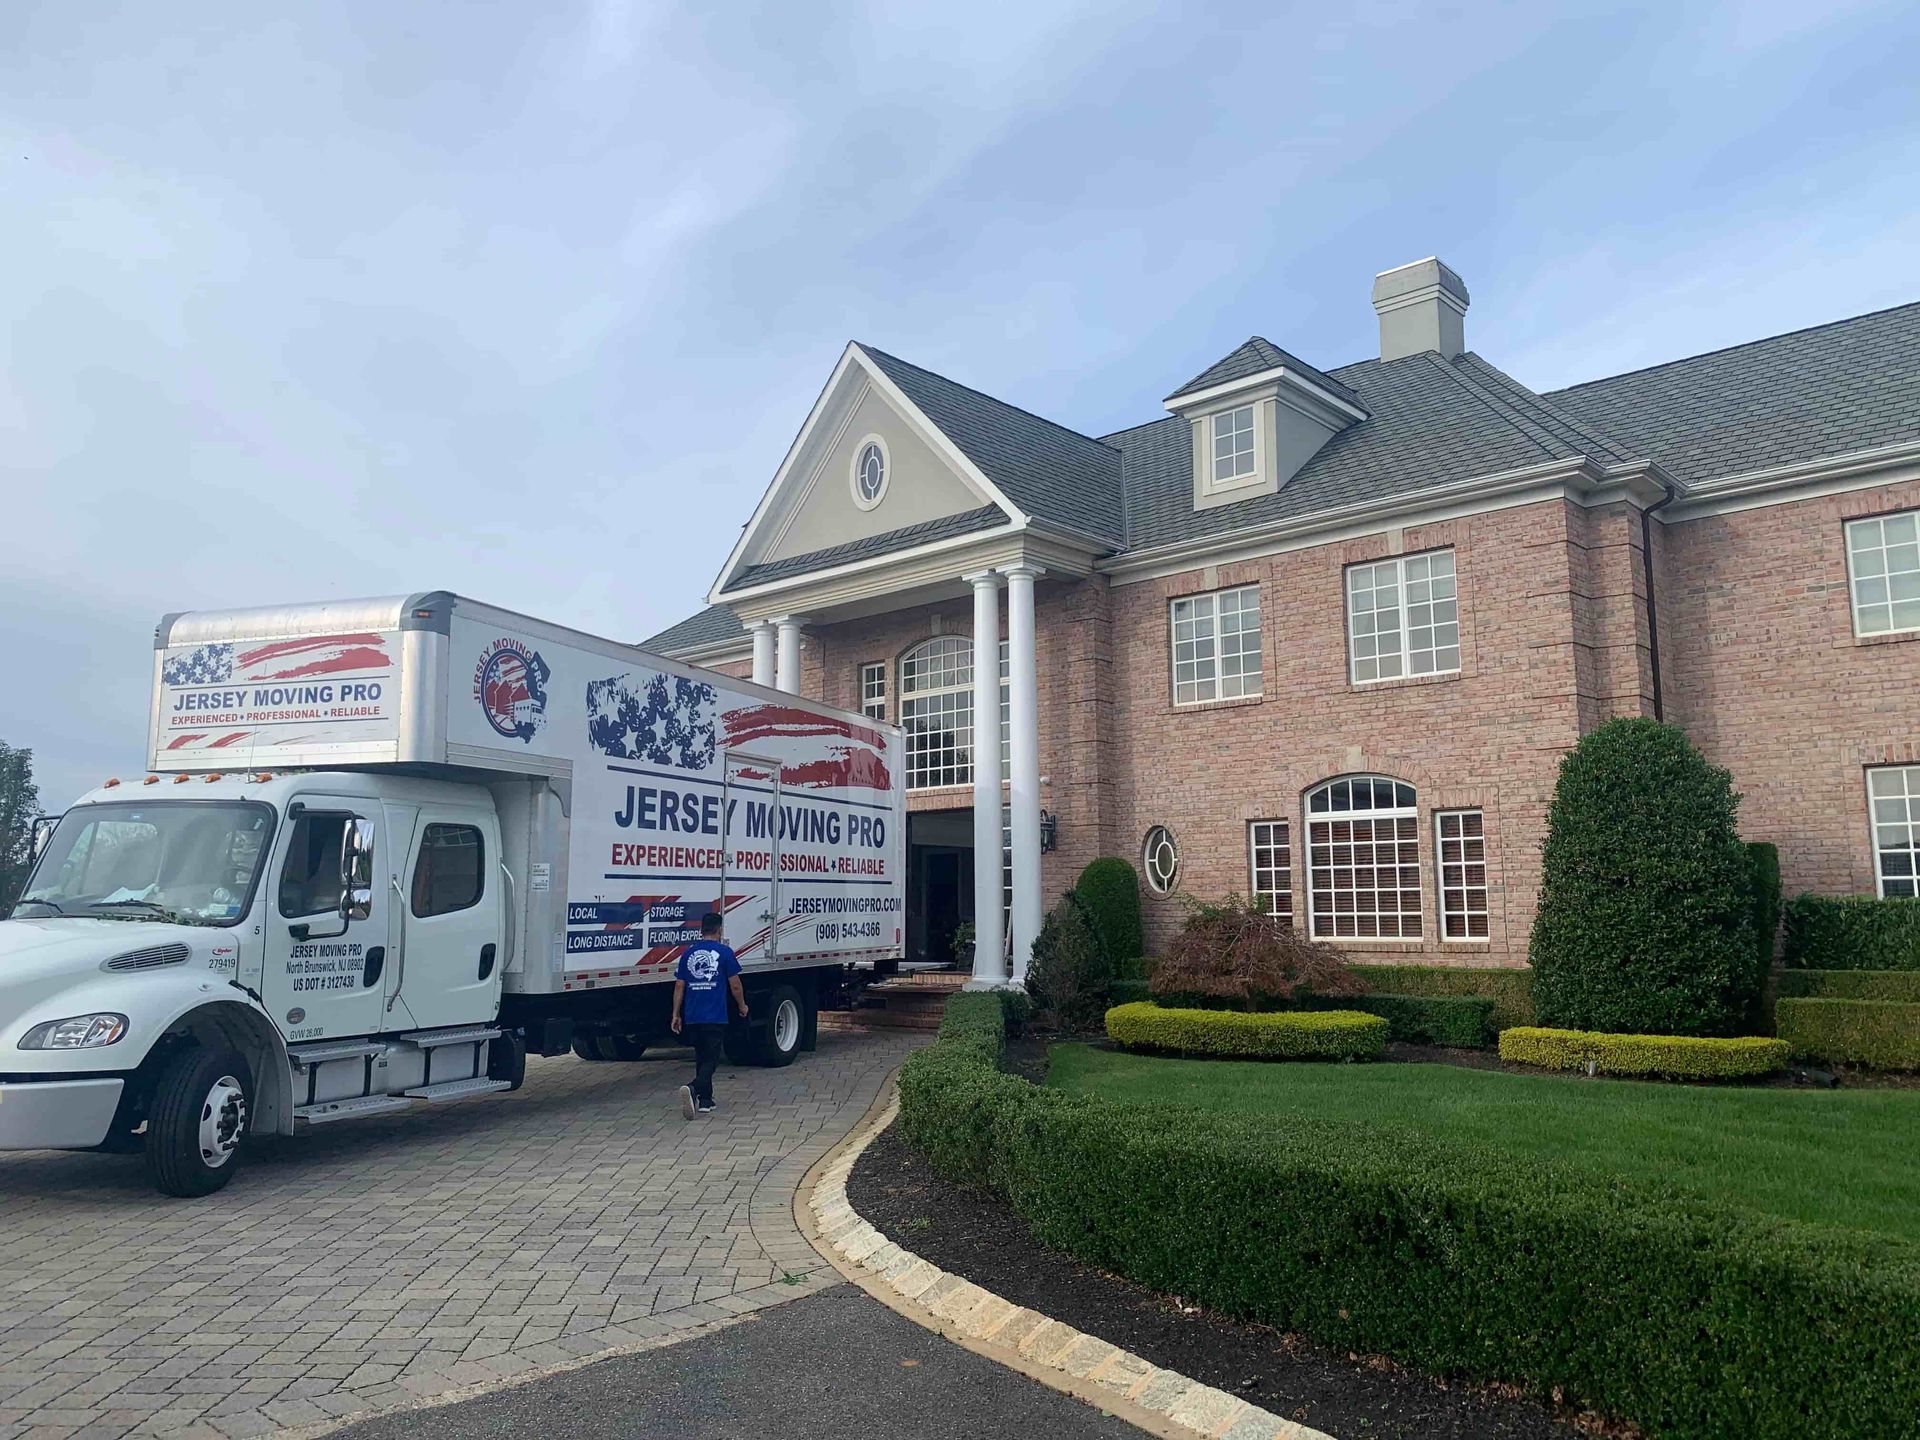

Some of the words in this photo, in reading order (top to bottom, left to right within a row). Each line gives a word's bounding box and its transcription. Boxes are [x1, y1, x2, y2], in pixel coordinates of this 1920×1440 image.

[473, 646, 491, 704] JERSEY
[493, 638, 533, 661] MOVING
[173, 690, 248, 711] JERSEY
[253, 686, 333, 706] MOVING
[340, 683, 382, 701] PRO
[171, 713, 238, 726] EXPERIENCED
[246, 709, 322, 721] PROFESSIONAL
[330, 706, 381, 717] RELIABLE
[614, 785, 738, 836] JERSEY
[746, 801, 841, 845] MOVING
[847, 814, 885, 848] PRO
[611, 843, 724, 869] EXPERIENCED
[736, 850, 829, 873] PROFSSIONAL
[838, 857, 885, 875] RELIABLE
[569, 907, 598, 920] LOCAL
[650, 906, 685, 918] STORAGE
[789, 898, 901, 914] JERSEYMOVINGPRO.COM
[254, 925, 261, 935] 5
[649, 930, 680, 944] FLORIDA
[816, 923, 840, 944] (908)
[842, 921, 881, 939] 543-4366
[568, 936, 593, 949] LONG
[593, 934, 634, 947] DISTANCE
[290, 945, 318, 959] JERSEY
[320, 944, 347, 957] MOVING
[348, 943, 363, 957] PRO
[208, 958, 236, 969] 279419
[286, 960, 304, 974] North
[293, 978, 304, 992] US
[305, 976, 320, 991] DOT
[326, 975, 355, 990] 3127438
